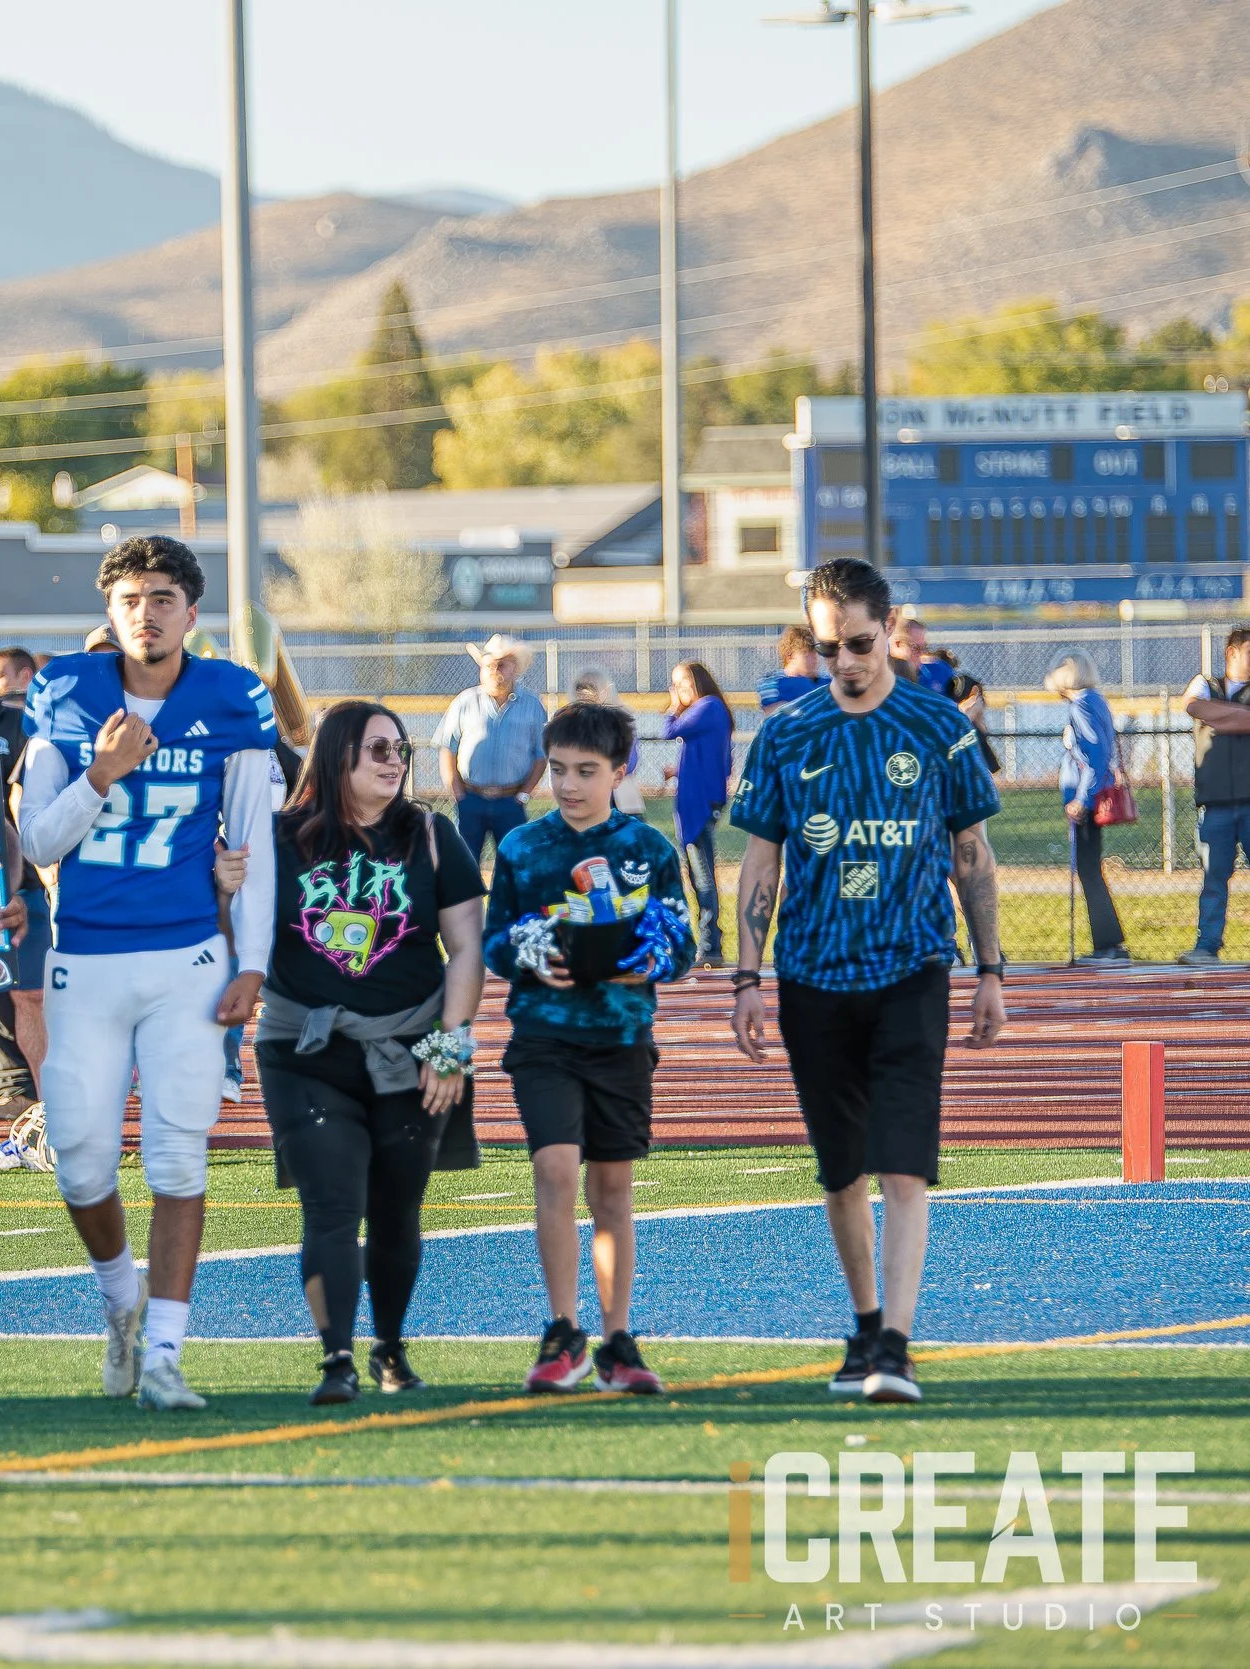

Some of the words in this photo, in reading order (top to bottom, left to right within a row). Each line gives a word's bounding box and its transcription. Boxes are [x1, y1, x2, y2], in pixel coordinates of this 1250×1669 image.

[1098, 400, 1191, 424] FIELD
[79, 742, 205, 773] STORS
[78, 781, 200, 869] 27
[843, 819, 919, 846] AT&T
[51, 966, 69, 990] C
